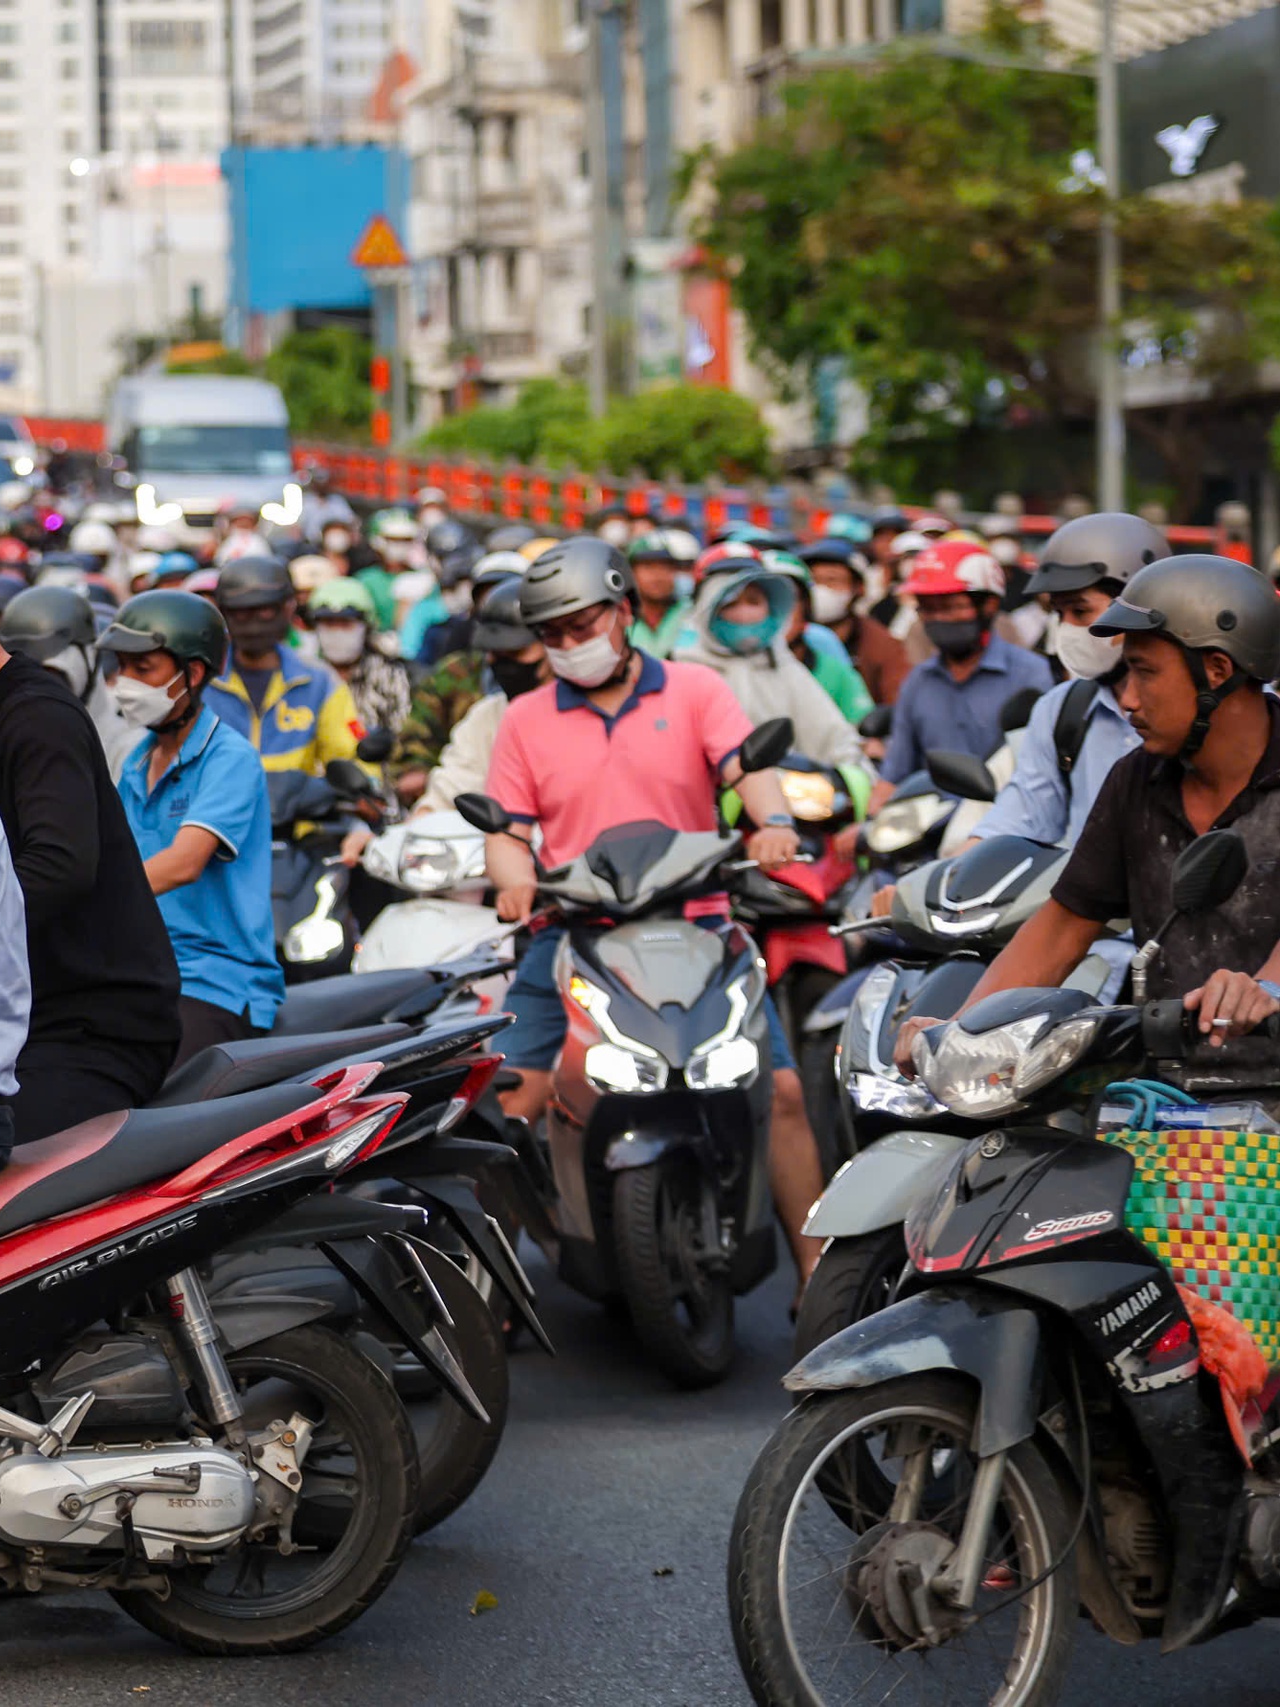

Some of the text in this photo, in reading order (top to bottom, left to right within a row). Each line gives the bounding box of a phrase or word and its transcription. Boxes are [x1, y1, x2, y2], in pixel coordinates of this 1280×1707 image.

[276, 700, 315, 732] be
[38, 1213, 199, 1293] AIR BLADE
[1094, 1281, 1162, 1336] YAMAHA
[167, 1498, 237, 1509] HONDA
